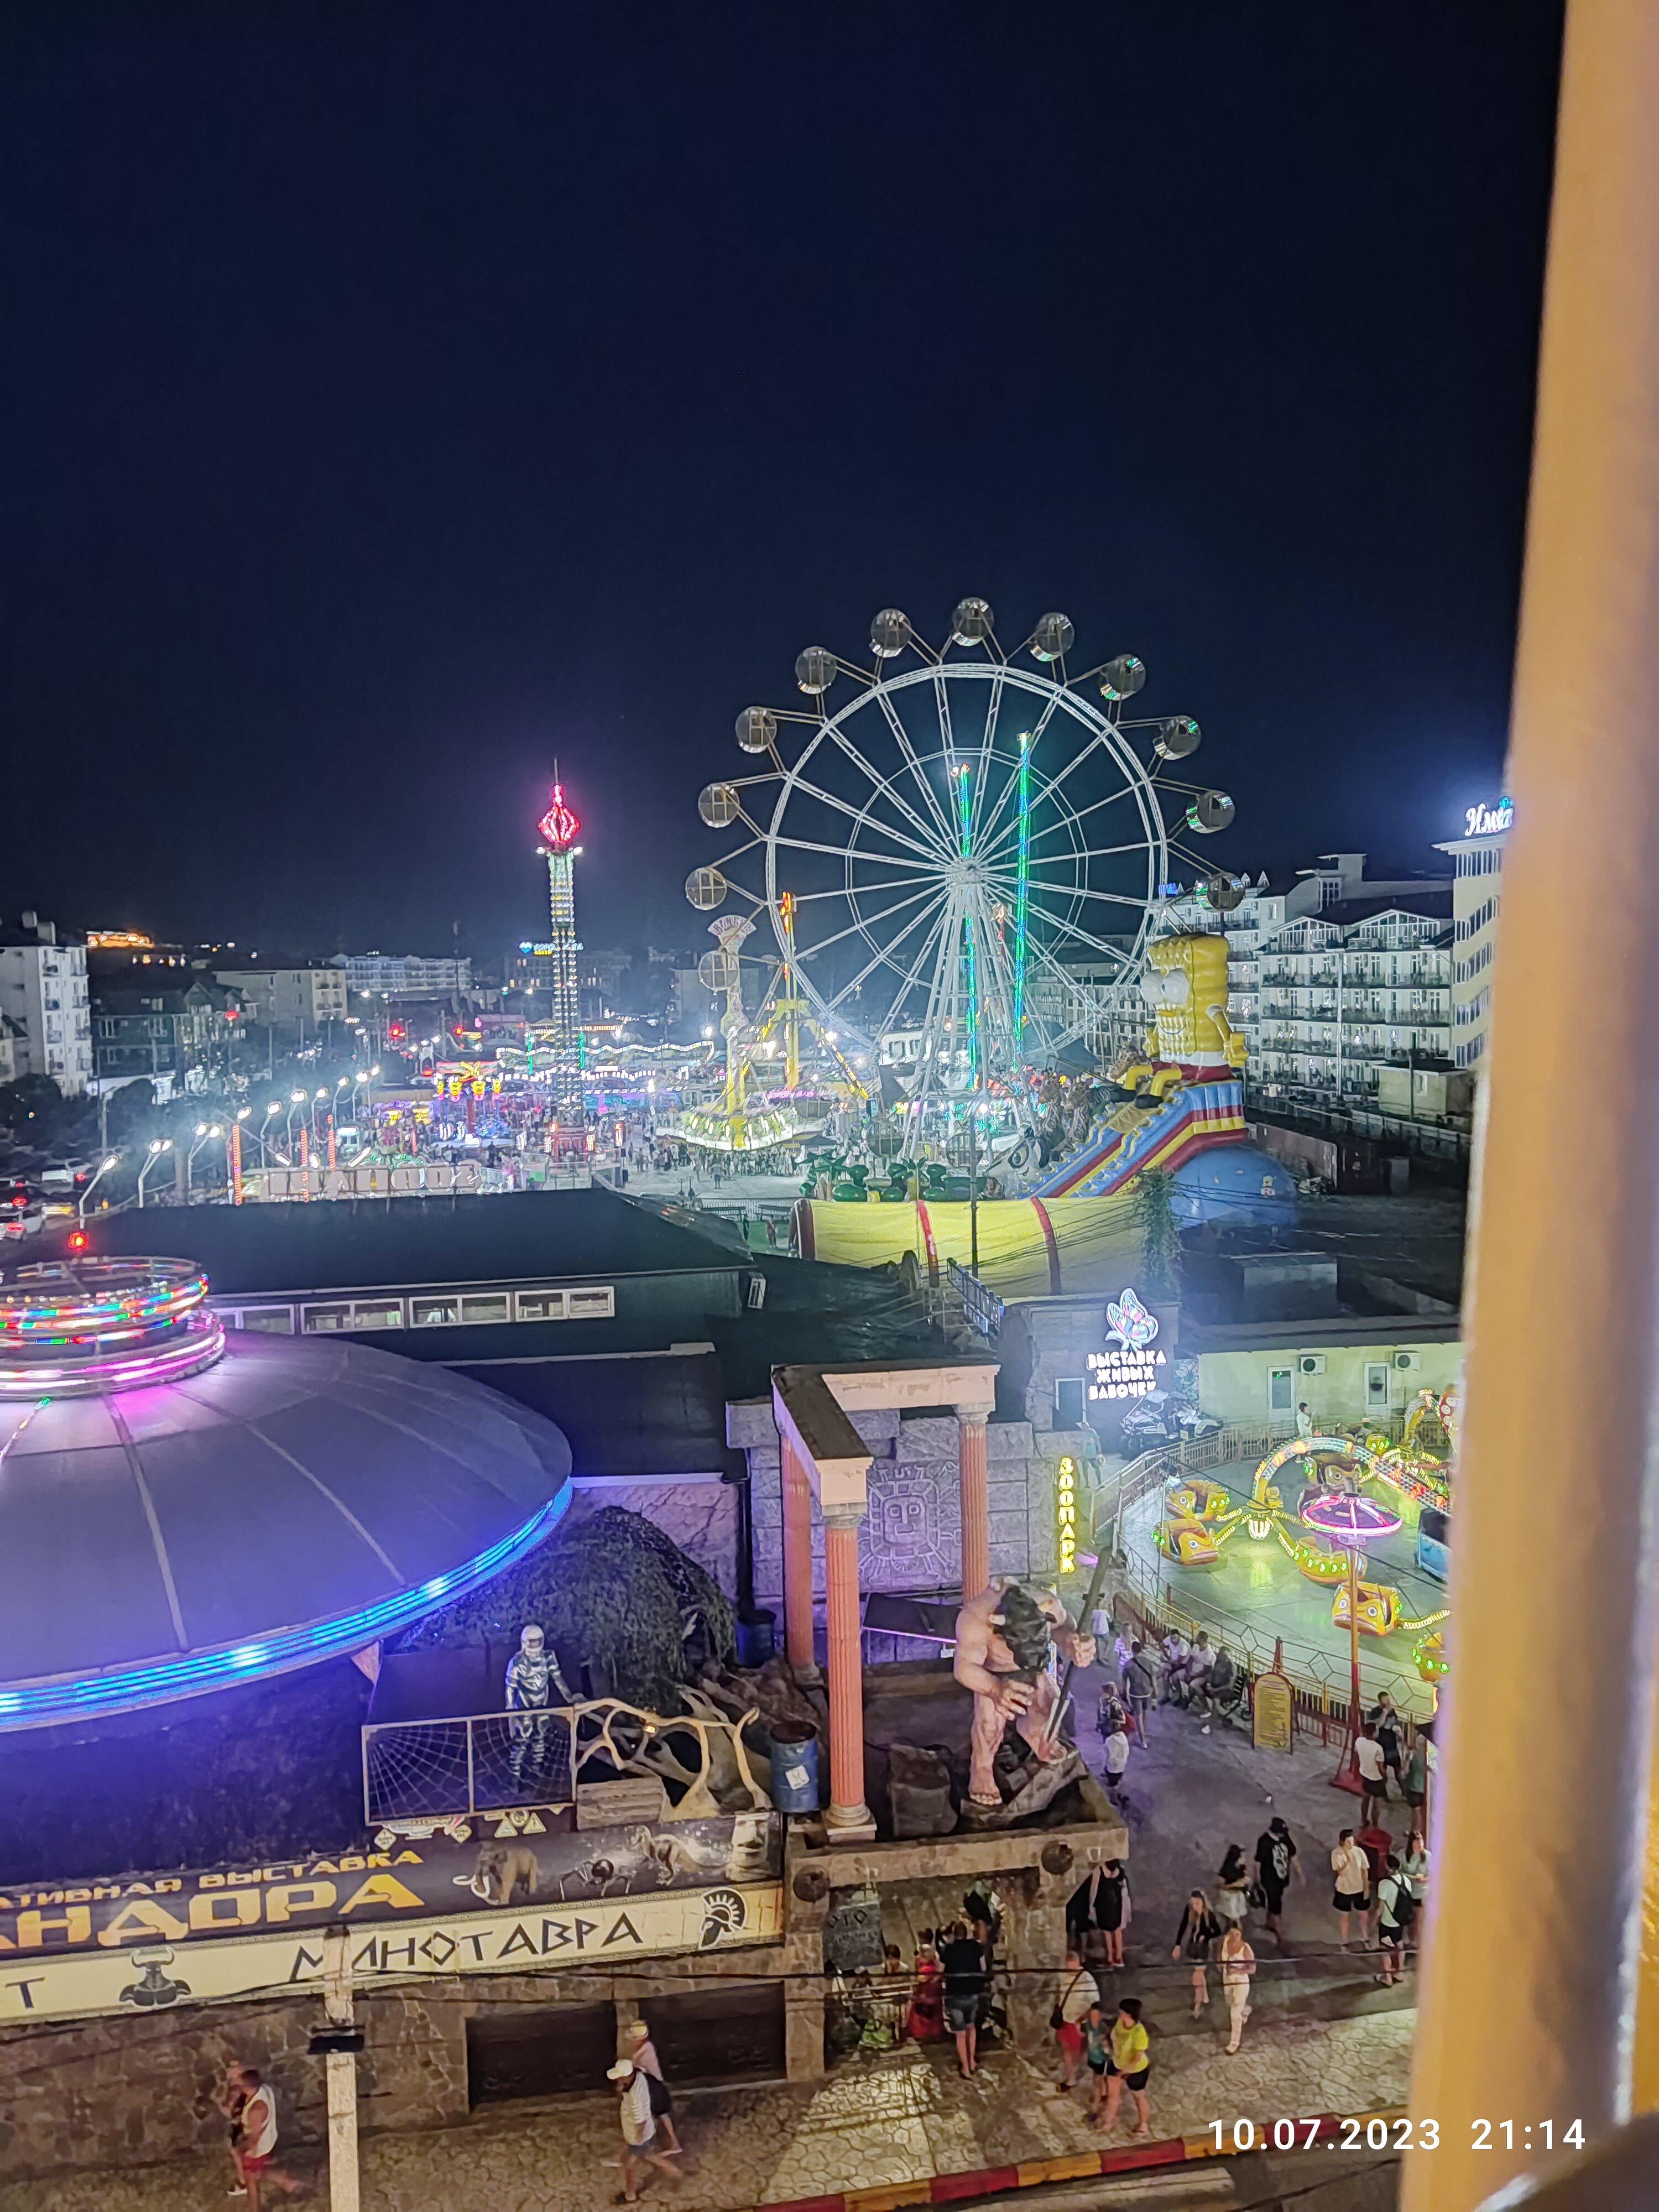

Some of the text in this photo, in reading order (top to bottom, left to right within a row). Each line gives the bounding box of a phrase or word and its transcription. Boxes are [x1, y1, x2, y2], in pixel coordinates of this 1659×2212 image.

[1087, 1349, 1167, 1369] ВЫСТАВКА
[1096, 1365, 1155, 1384] ЖИВЫХ
[1088, 1381, 1156, 1400] БАБОЧЕК
[1059, 1457, 1076, 1573] ЗООПАРК
[199, 1850, 424, 1890] ВЫСТАВКА
[0, 1874, 425, 1950] НДОРА
[5, 1911, 644, 2008] Т МИНОТАВРА
